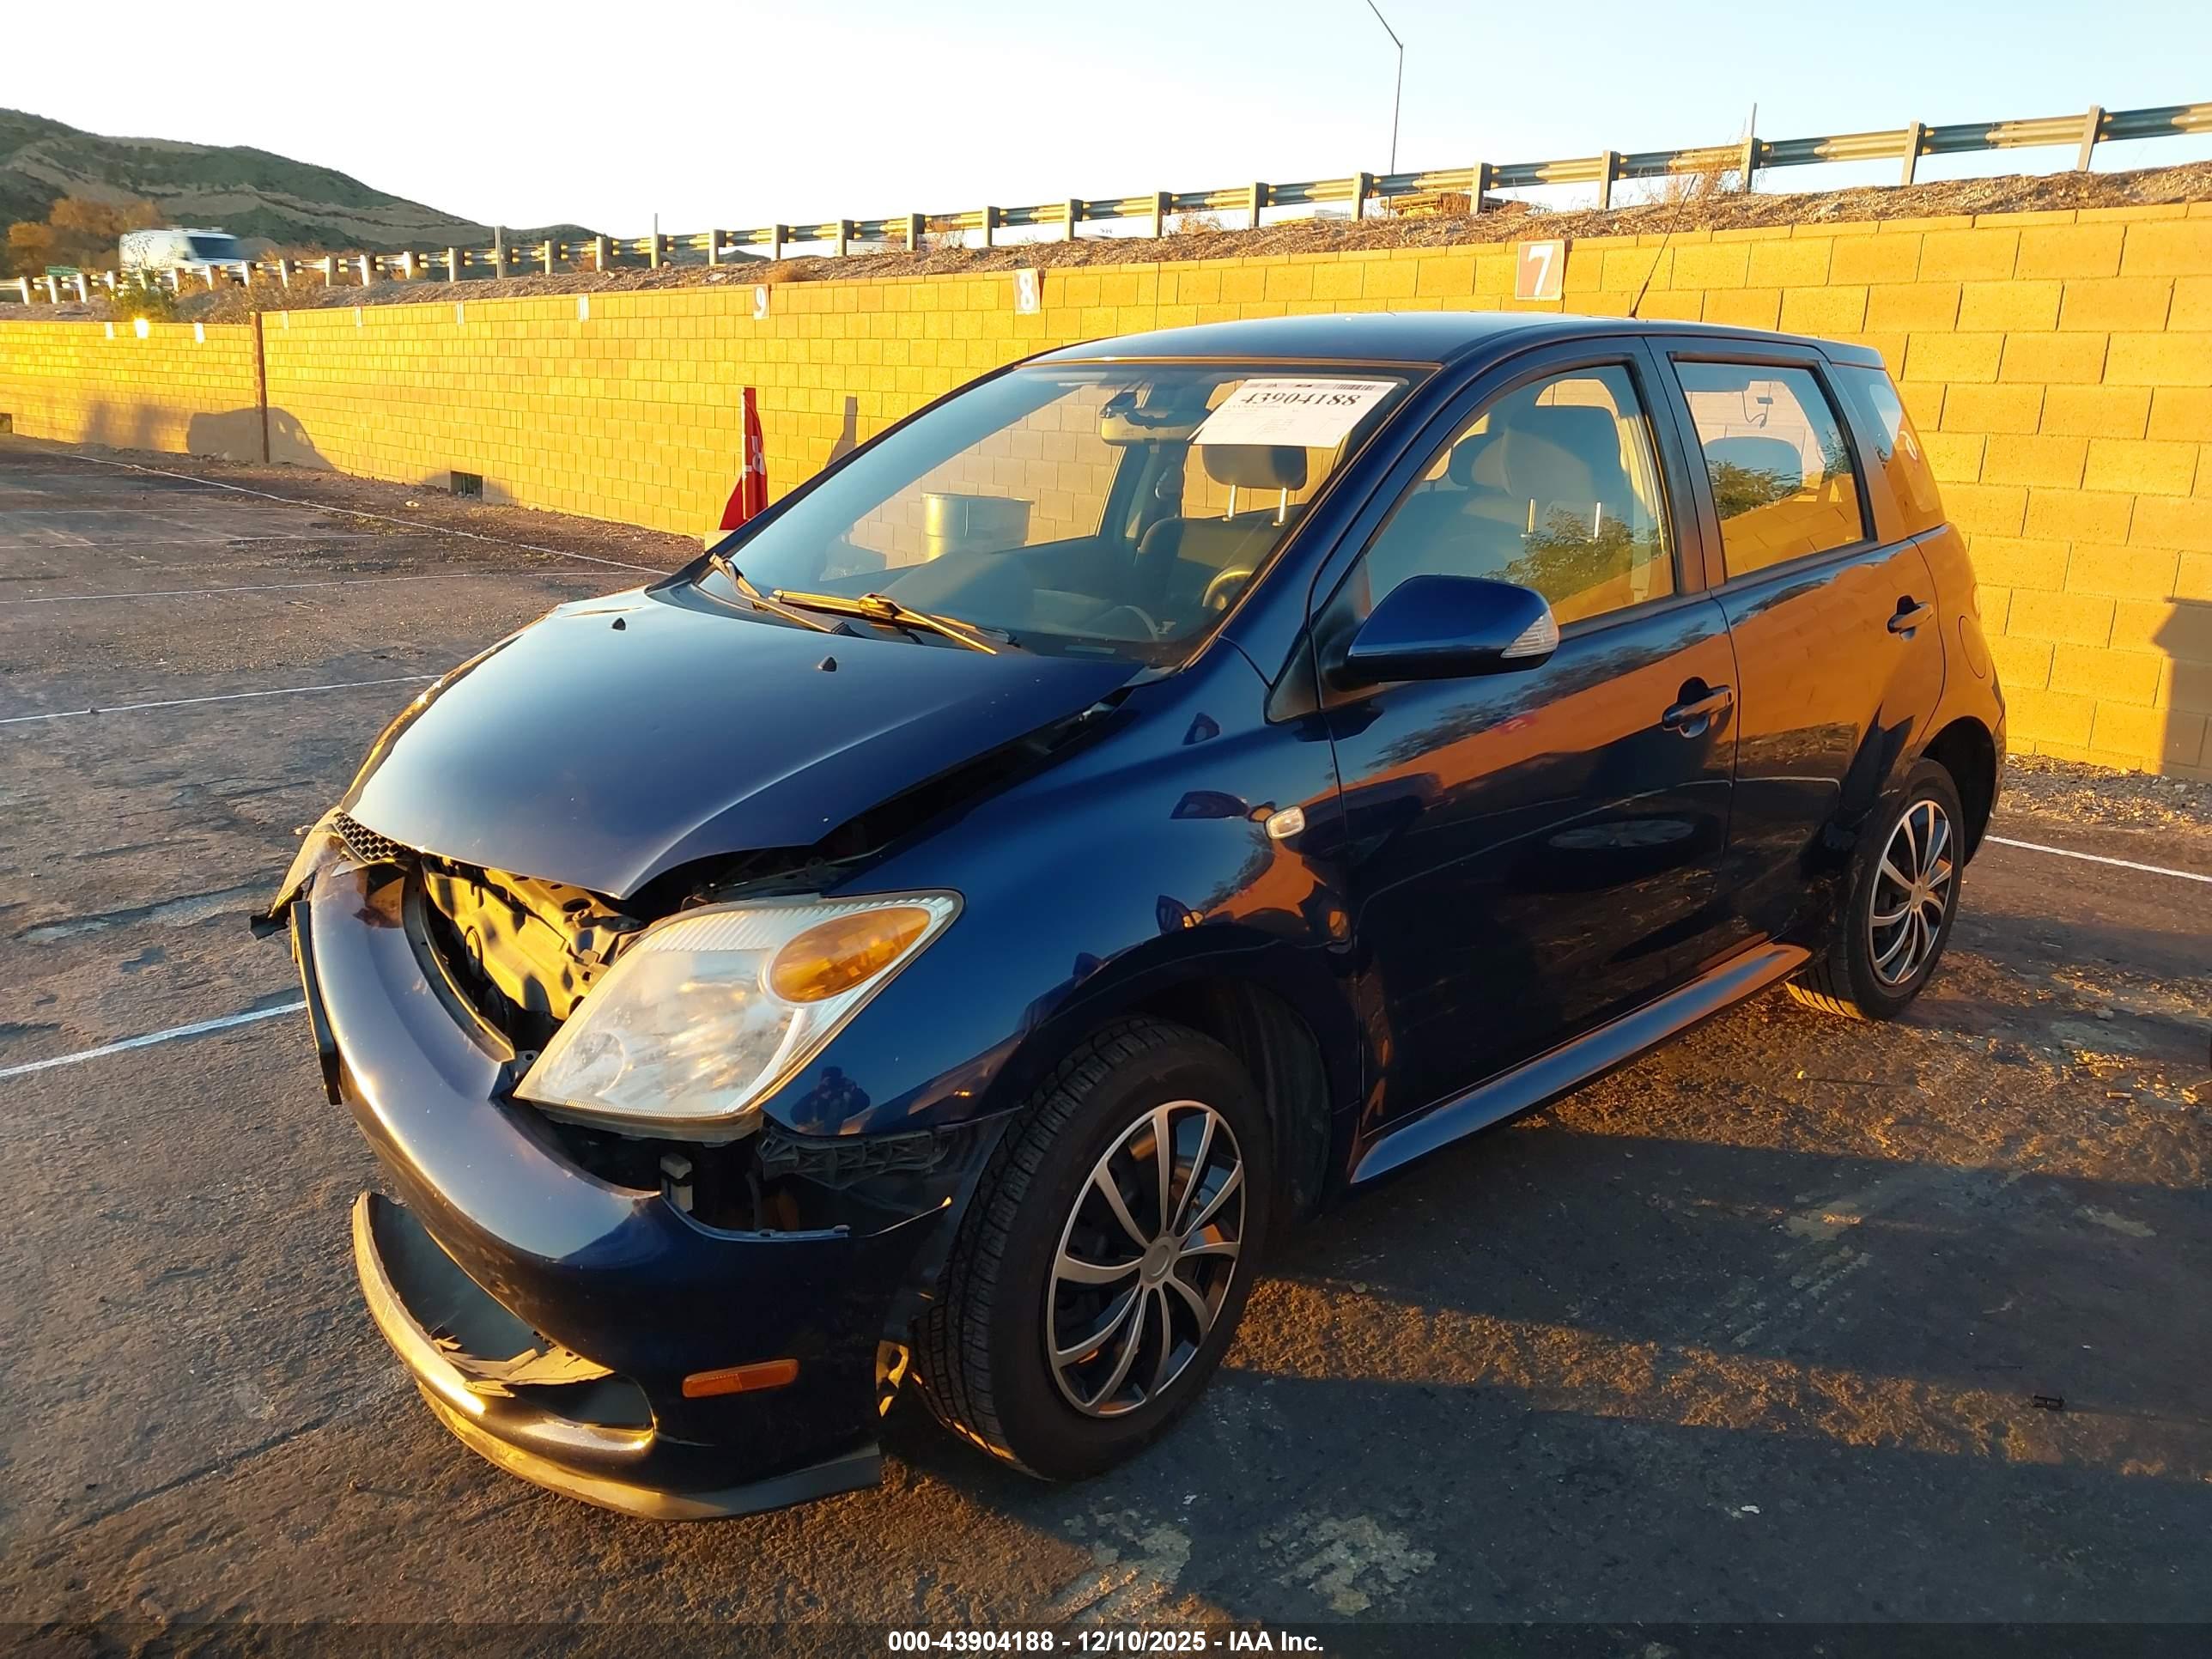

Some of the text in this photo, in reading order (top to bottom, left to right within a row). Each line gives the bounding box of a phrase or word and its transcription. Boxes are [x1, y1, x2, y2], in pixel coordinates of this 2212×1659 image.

[1528, 245, 1553, 296] 7
[754, 287, 767, 319] 9
[1018, 271, 1035, 311] 8
[1241, 392, 1361, 406] 43904188
